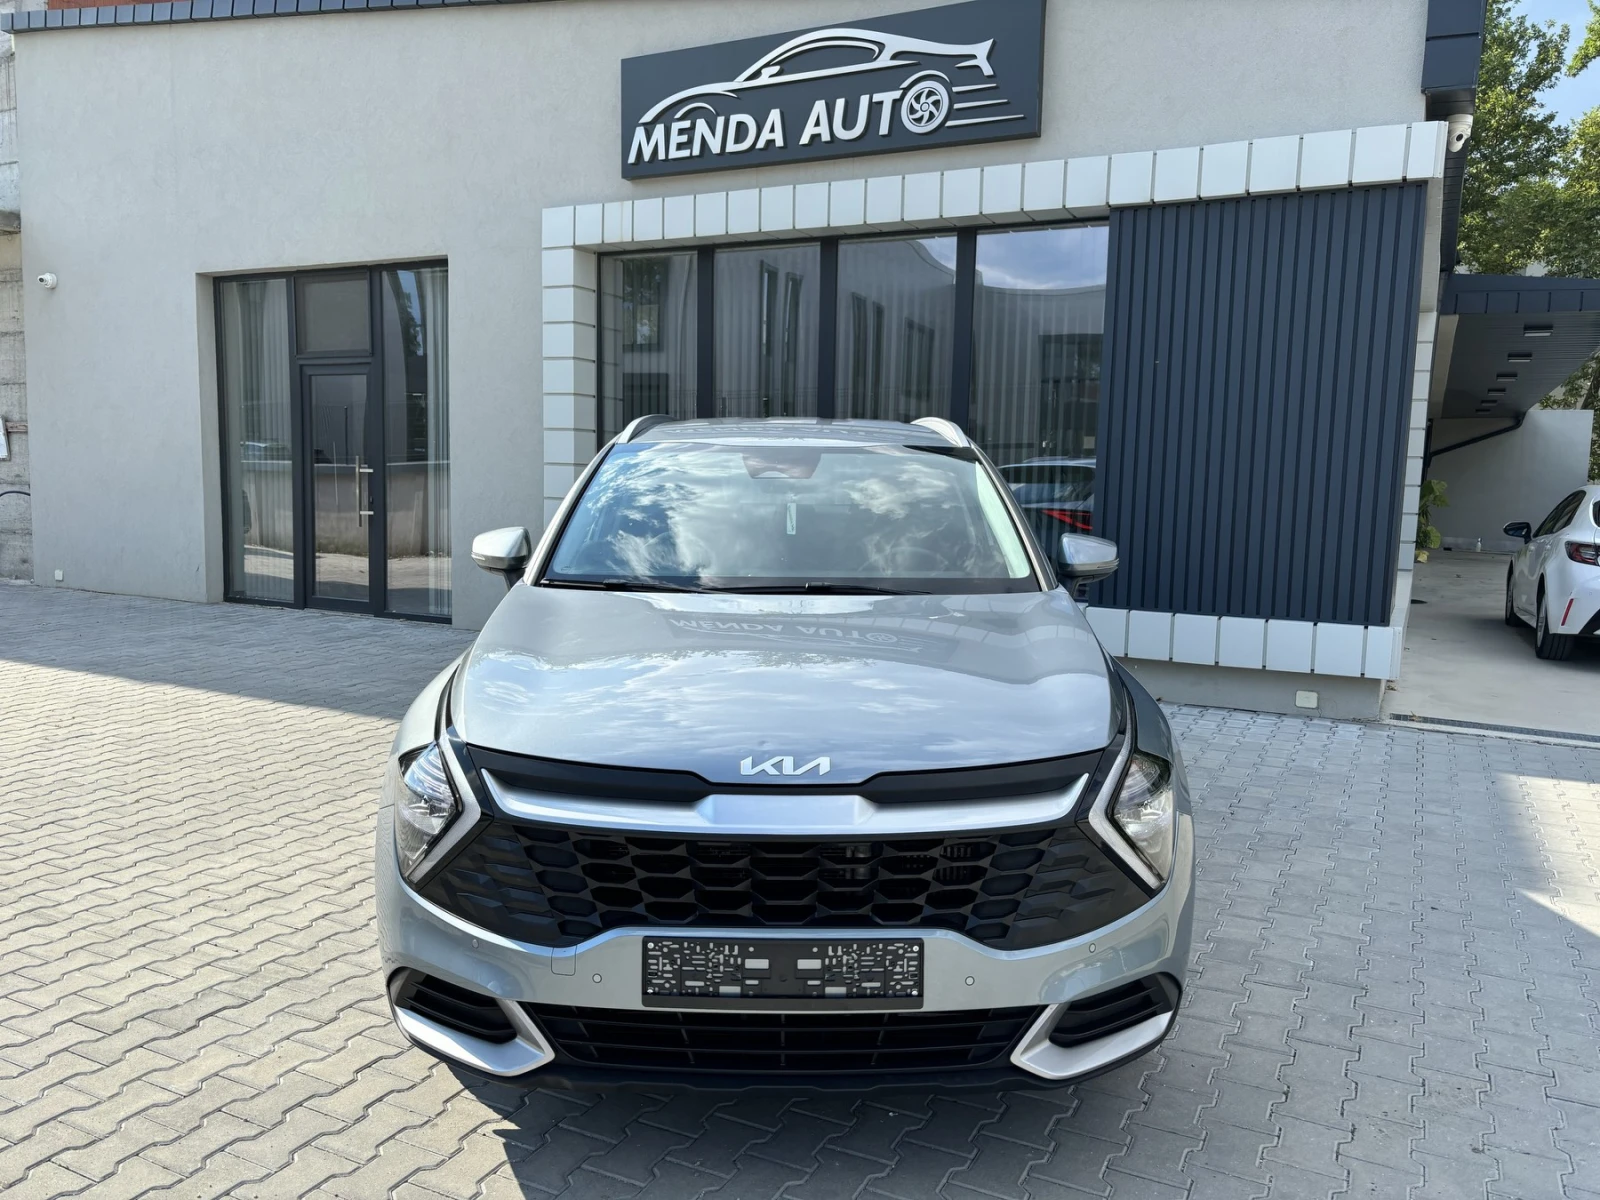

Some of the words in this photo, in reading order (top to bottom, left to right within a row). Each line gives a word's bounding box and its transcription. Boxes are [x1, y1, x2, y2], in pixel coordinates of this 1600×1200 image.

[627, 108, 785, 164] MENDA
[799, 80, 950, 145] AUTO
[740, 755, 831, 776] KIA
